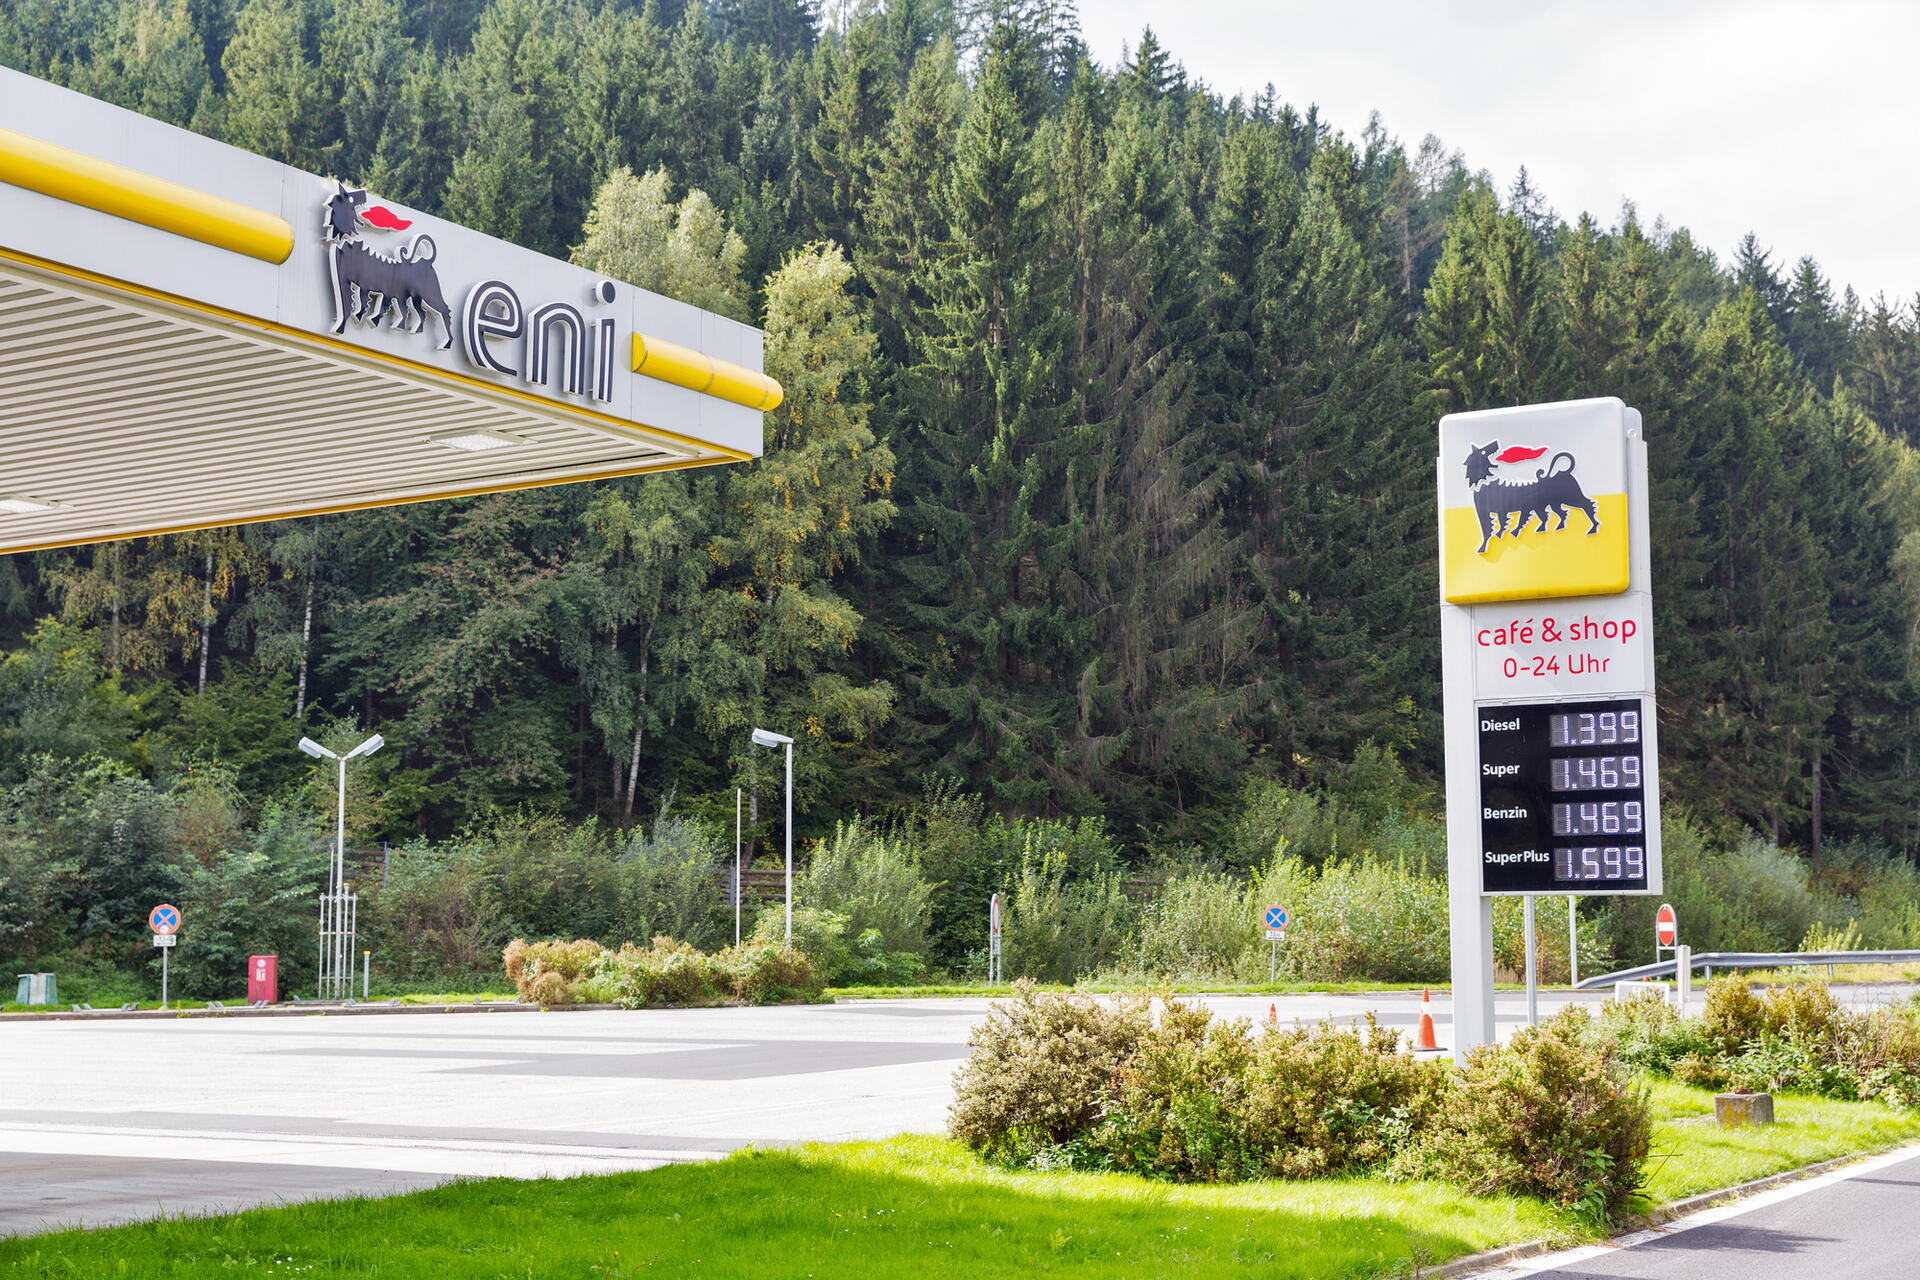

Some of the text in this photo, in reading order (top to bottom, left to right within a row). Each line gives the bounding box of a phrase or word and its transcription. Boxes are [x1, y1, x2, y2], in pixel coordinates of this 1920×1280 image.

[463, 279, 616, 403] eni
[1477, 615, 1637, 646] café & shop
[1503, 653, 1610, 678] 0-24 Uhr
[1481, 711, 1639, 744] Diesel 1.399
[1482, 756, 1640, 789] Super 1.469
[1483, 801, 1642, 833] Benzin 1.469
[1567, 847, 1644, 879] 1.599
